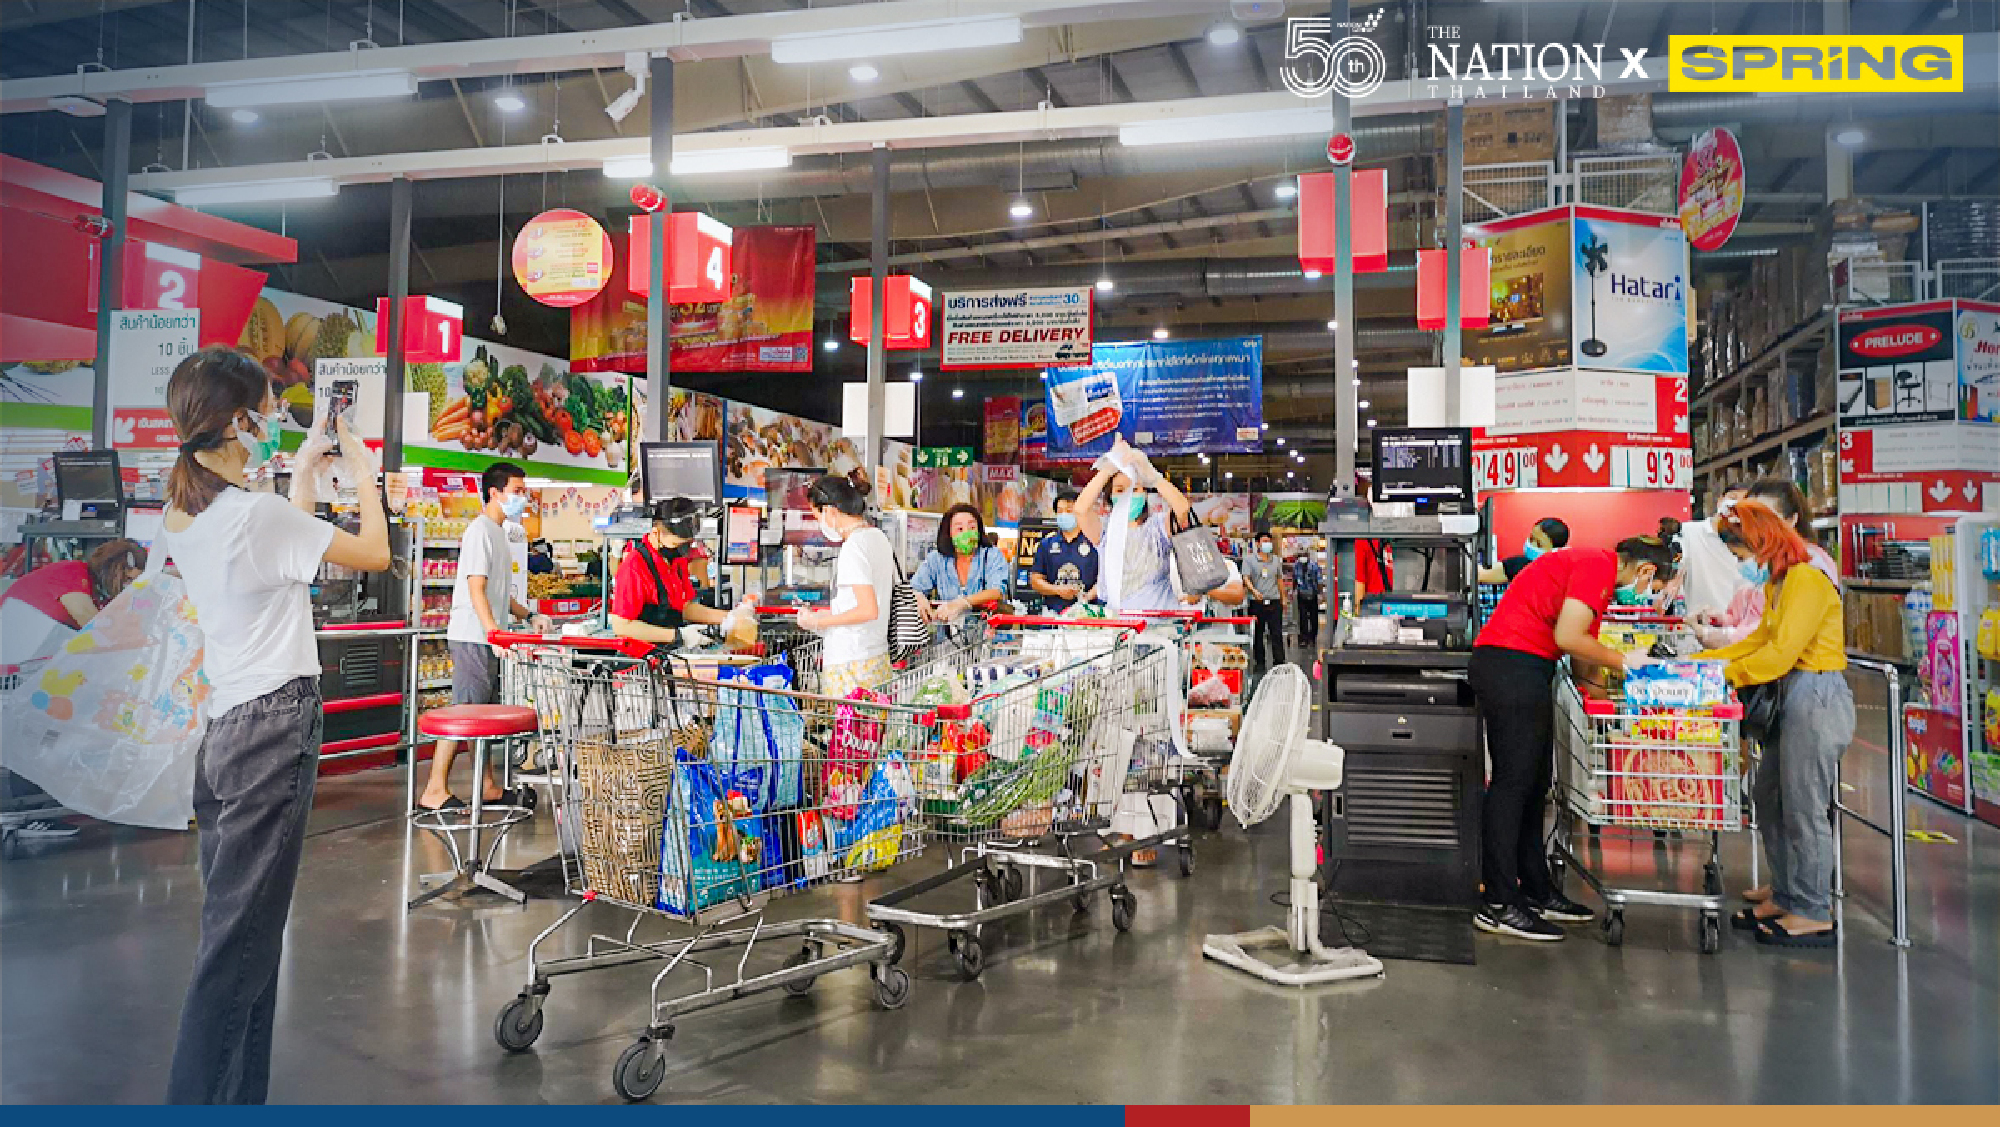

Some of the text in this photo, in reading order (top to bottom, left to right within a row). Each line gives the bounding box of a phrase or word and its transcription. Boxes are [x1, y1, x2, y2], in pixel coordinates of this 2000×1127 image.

[707, 247, 723, 290] 4
[157, 270, 185, 311] 2
[1611, 273, 1681, 301] Hatari
[913, 302, 926, 338] 3
[157, 342, 173, 356] 10
[438, 319, 450, 354] 1
[947, 327, 1086, 344] FREE DELIVERY
[1865, 331, 1923, 349] PRELUDE
[1675, 378, 1687, 402] 2
[1841, 432, 1853, 449] 3
[1647, 451, 1675, 486] 93
